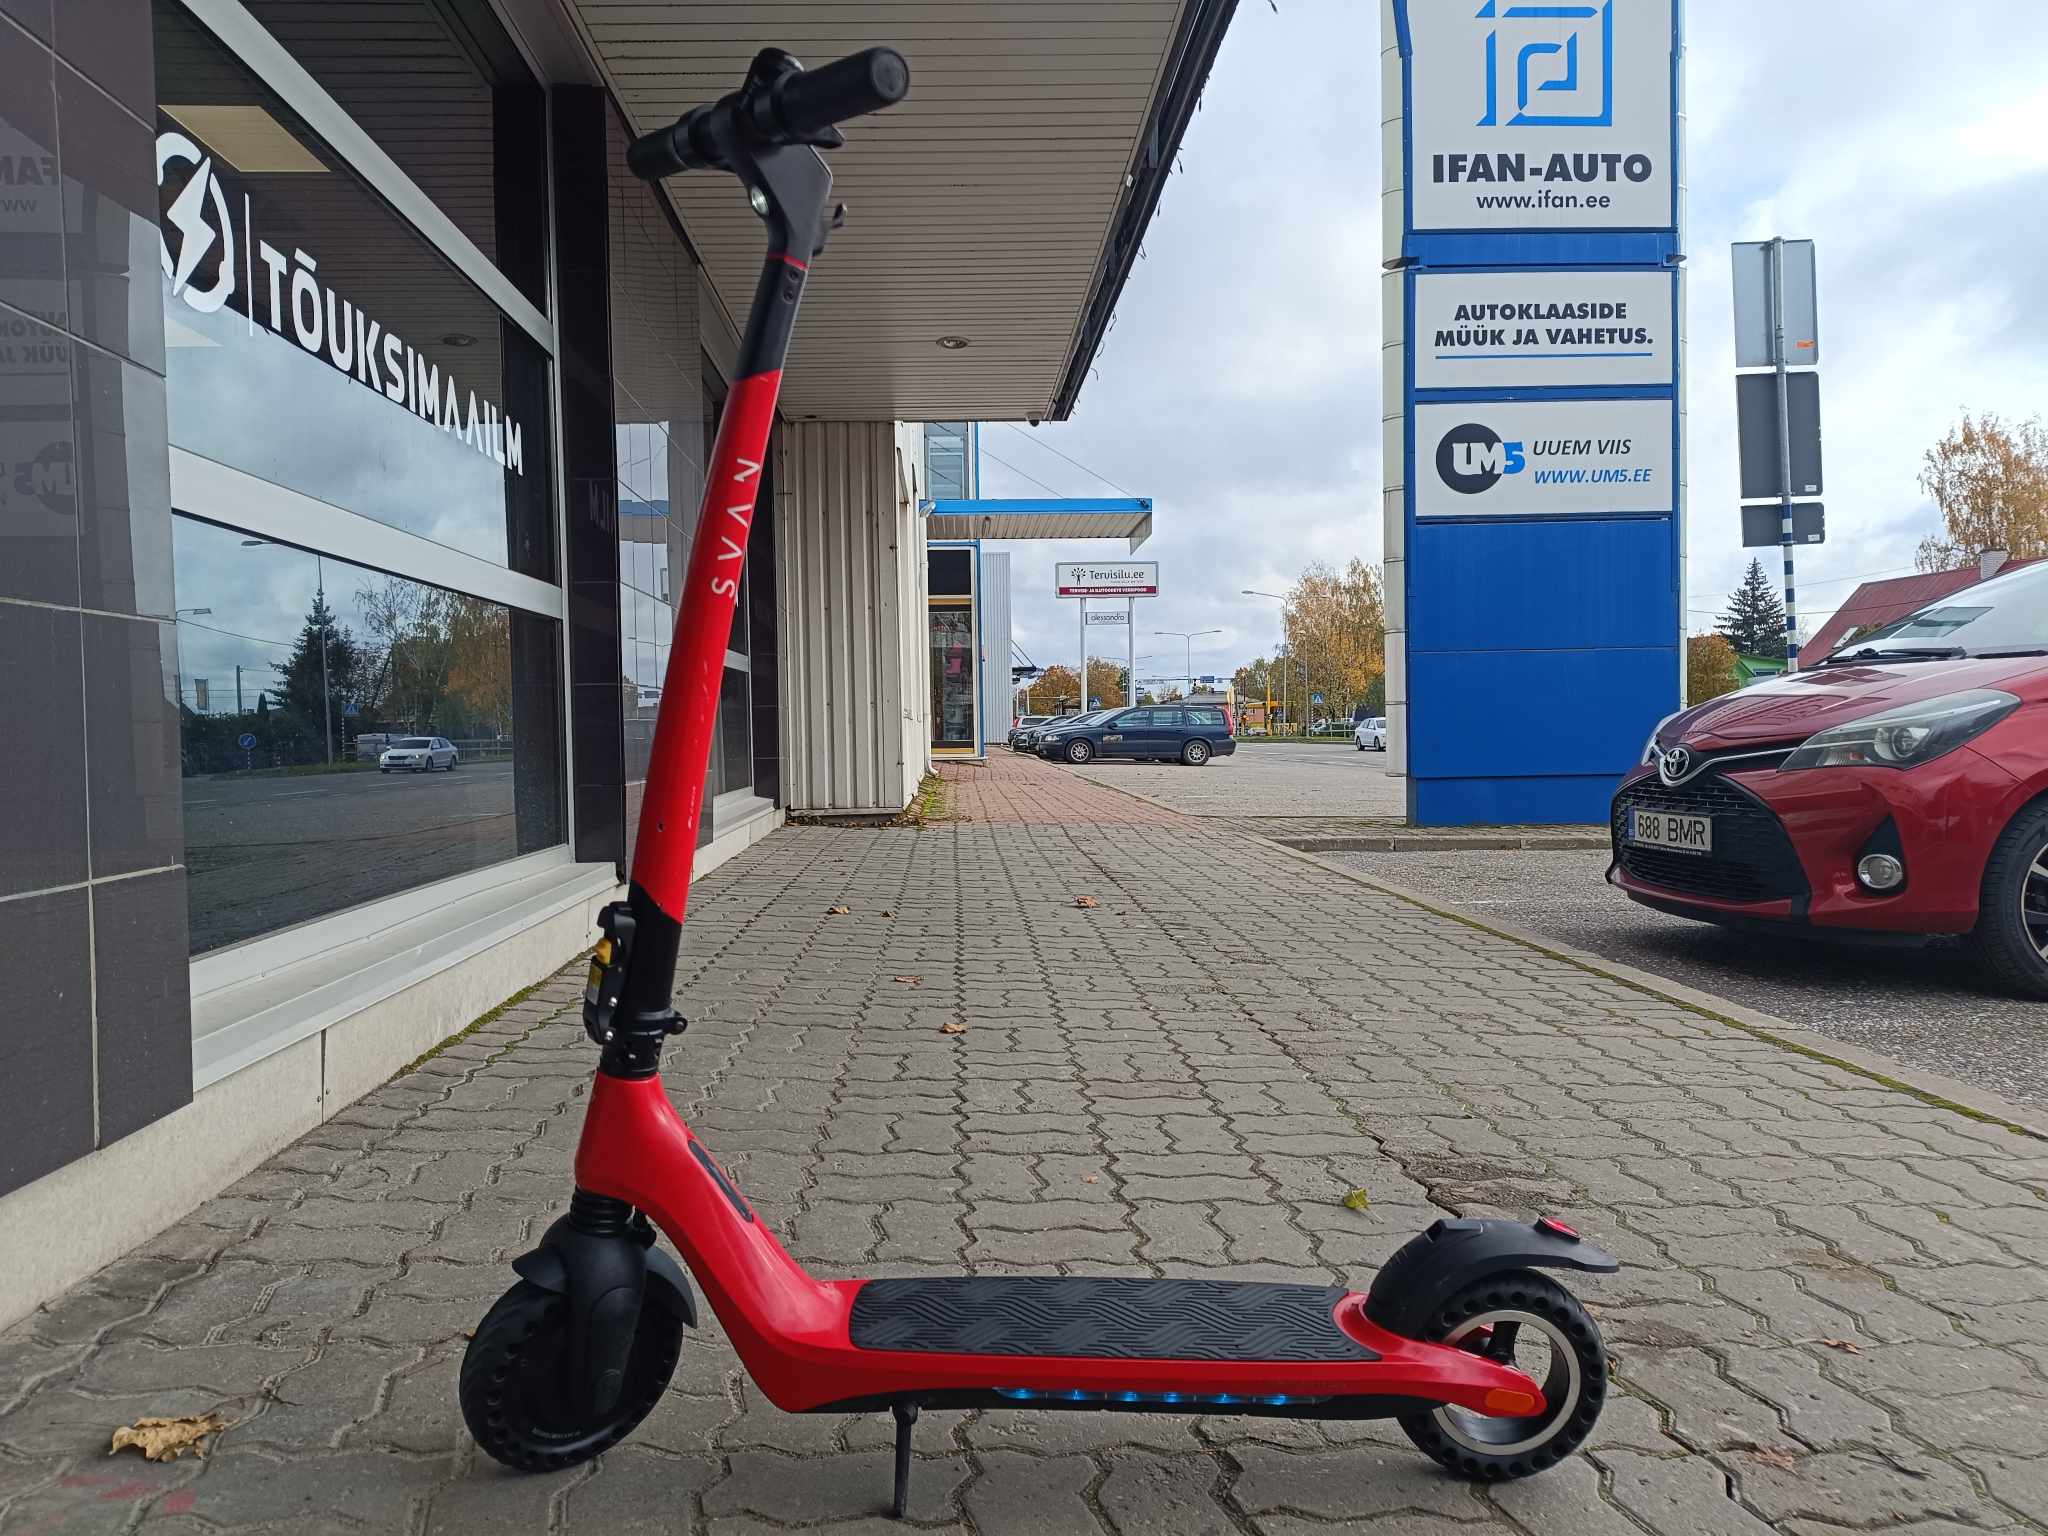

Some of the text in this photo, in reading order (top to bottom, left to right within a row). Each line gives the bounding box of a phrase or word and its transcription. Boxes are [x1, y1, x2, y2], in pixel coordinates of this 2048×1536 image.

[1433, 153, 1652, 183] IFAN-AUTO
[1476, 189, 1611, 208] www.ifan.ee
[1454, 303, 1627, 321] AUTOKLAASIDE
[1435, 324, 1653, 346] MÜÜK JA VAHETUS.
[1533, 439, 1632, 455] UUEM VIIS
[1453, 441, 1525, 475] UM5
[1534, 468, 1653, 484] WWW.UM5.EE
[1089, 569, 1144, 580] Tervisilu.ee
[1638, 815, 1705, 845] 688 BMR
